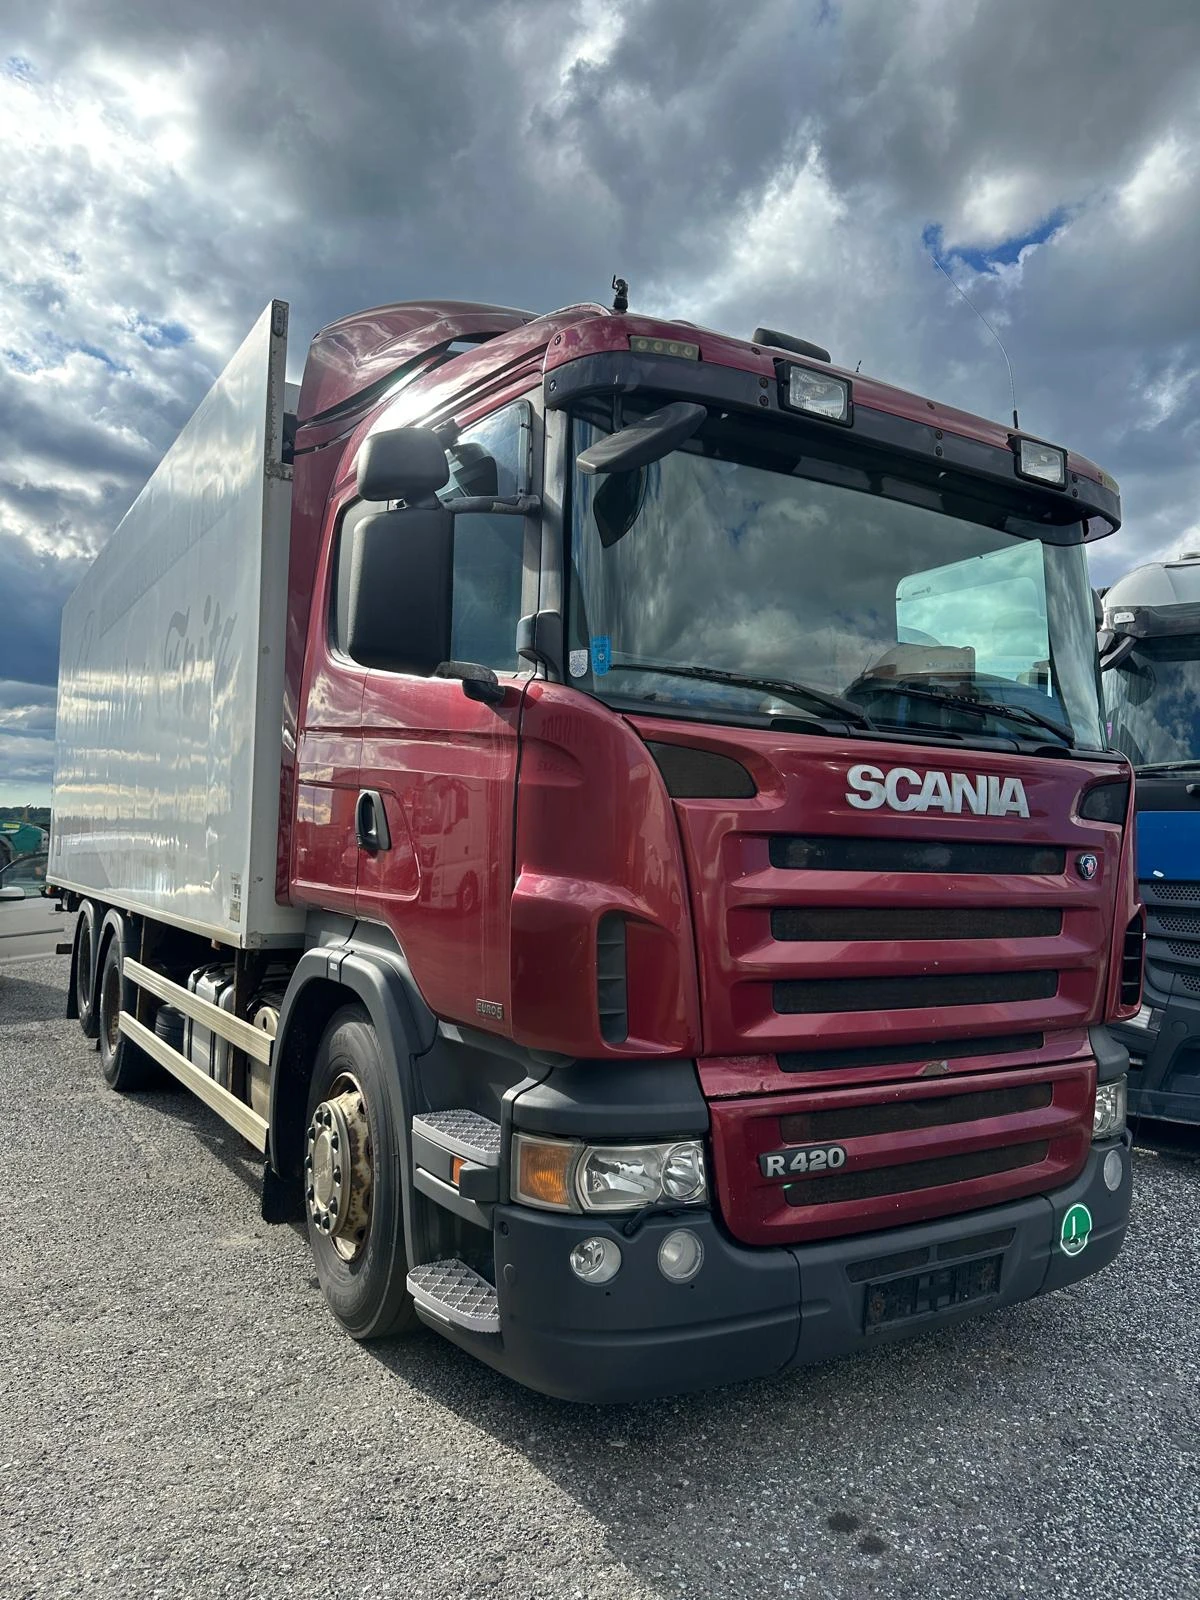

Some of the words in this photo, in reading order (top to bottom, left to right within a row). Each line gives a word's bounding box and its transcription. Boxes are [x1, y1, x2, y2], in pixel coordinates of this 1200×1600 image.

[845, 764, 1031, 818] SCANIA
[766, 1155, 786, 1177] R
[789, 1147, 845, 1173] 420
